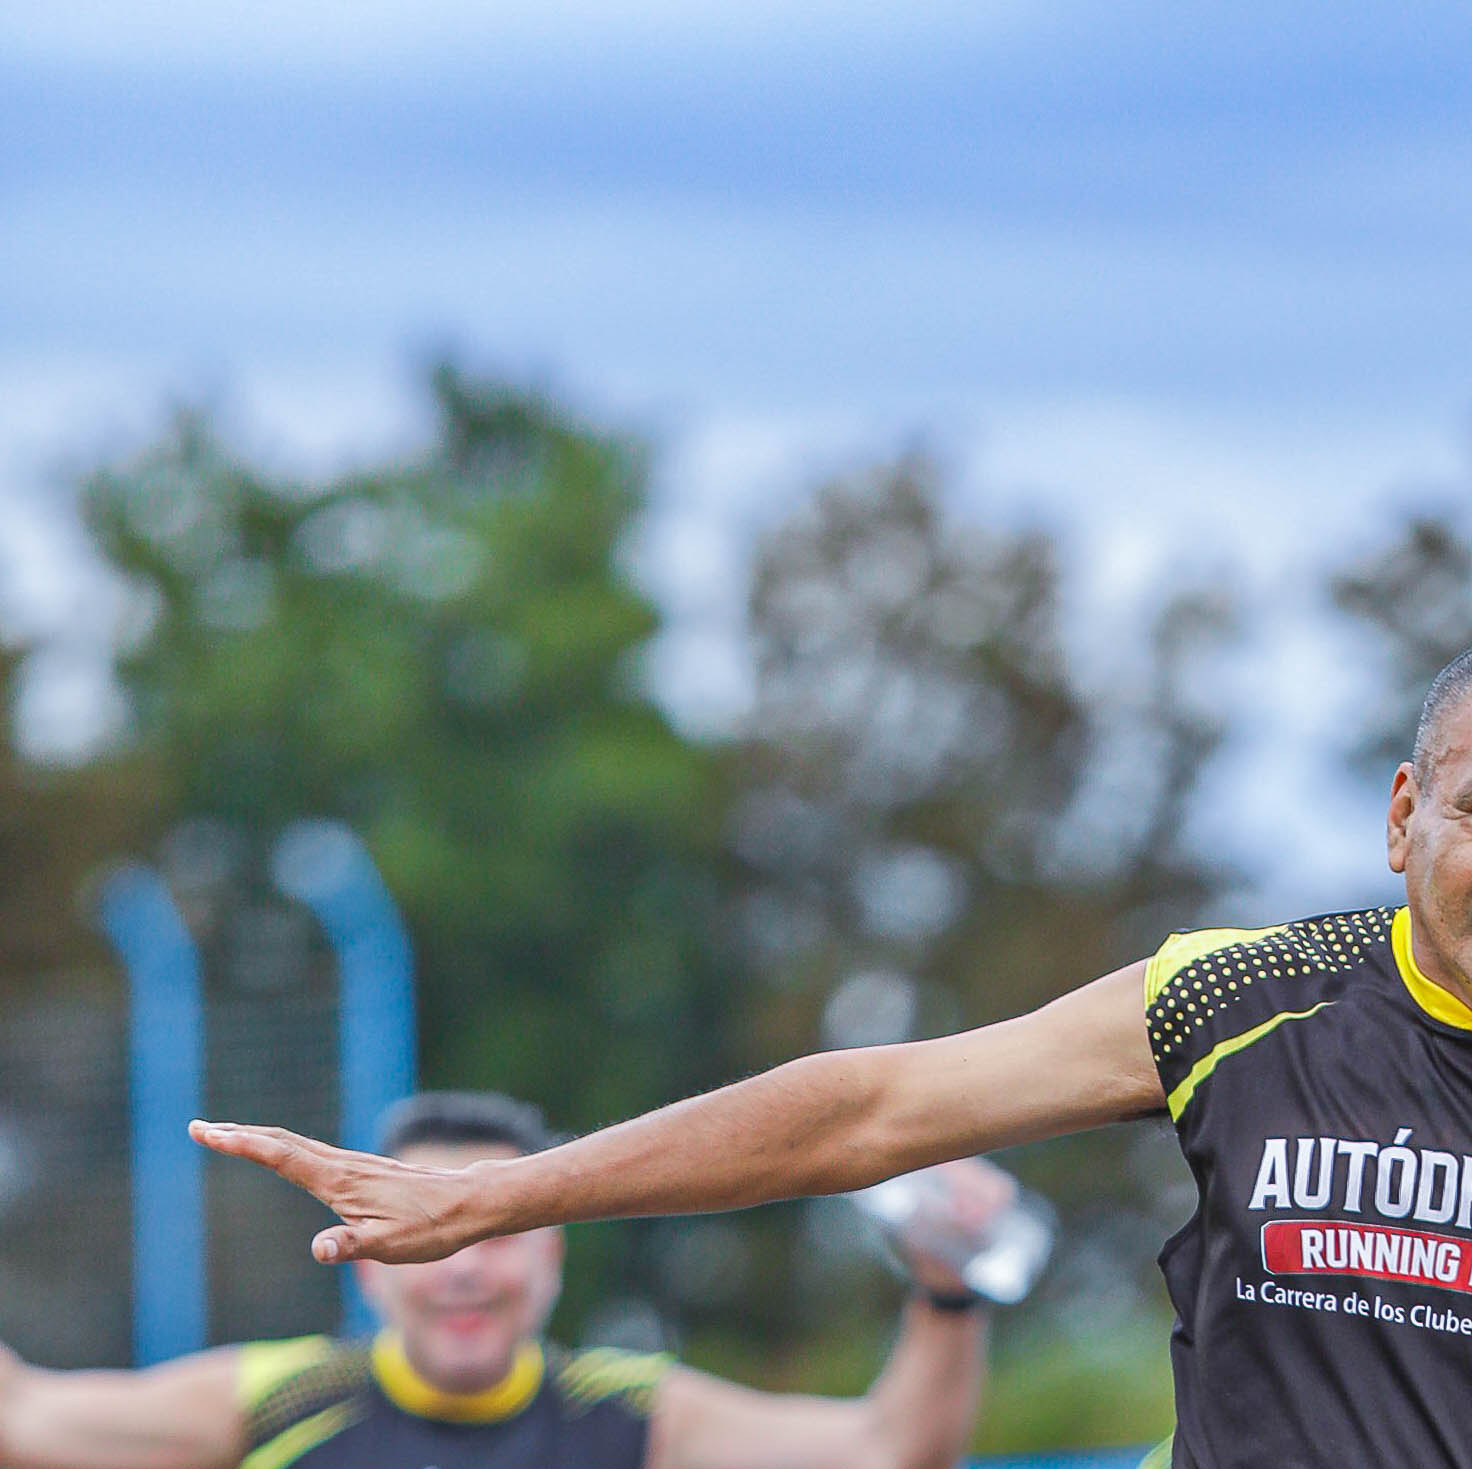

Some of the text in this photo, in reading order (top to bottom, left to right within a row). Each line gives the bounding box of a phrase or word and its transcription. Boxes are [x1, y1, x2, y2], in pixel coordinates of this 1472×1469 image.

[1300, 1228, 1461, 1283] RUNNING
[1236, 1277, 1256, 1302] La
[1260, 1281, 1338, 1313] Carrera
[1343, 1292, 1370, 1317] de
[1374, 1296, 1405, 1324] los
